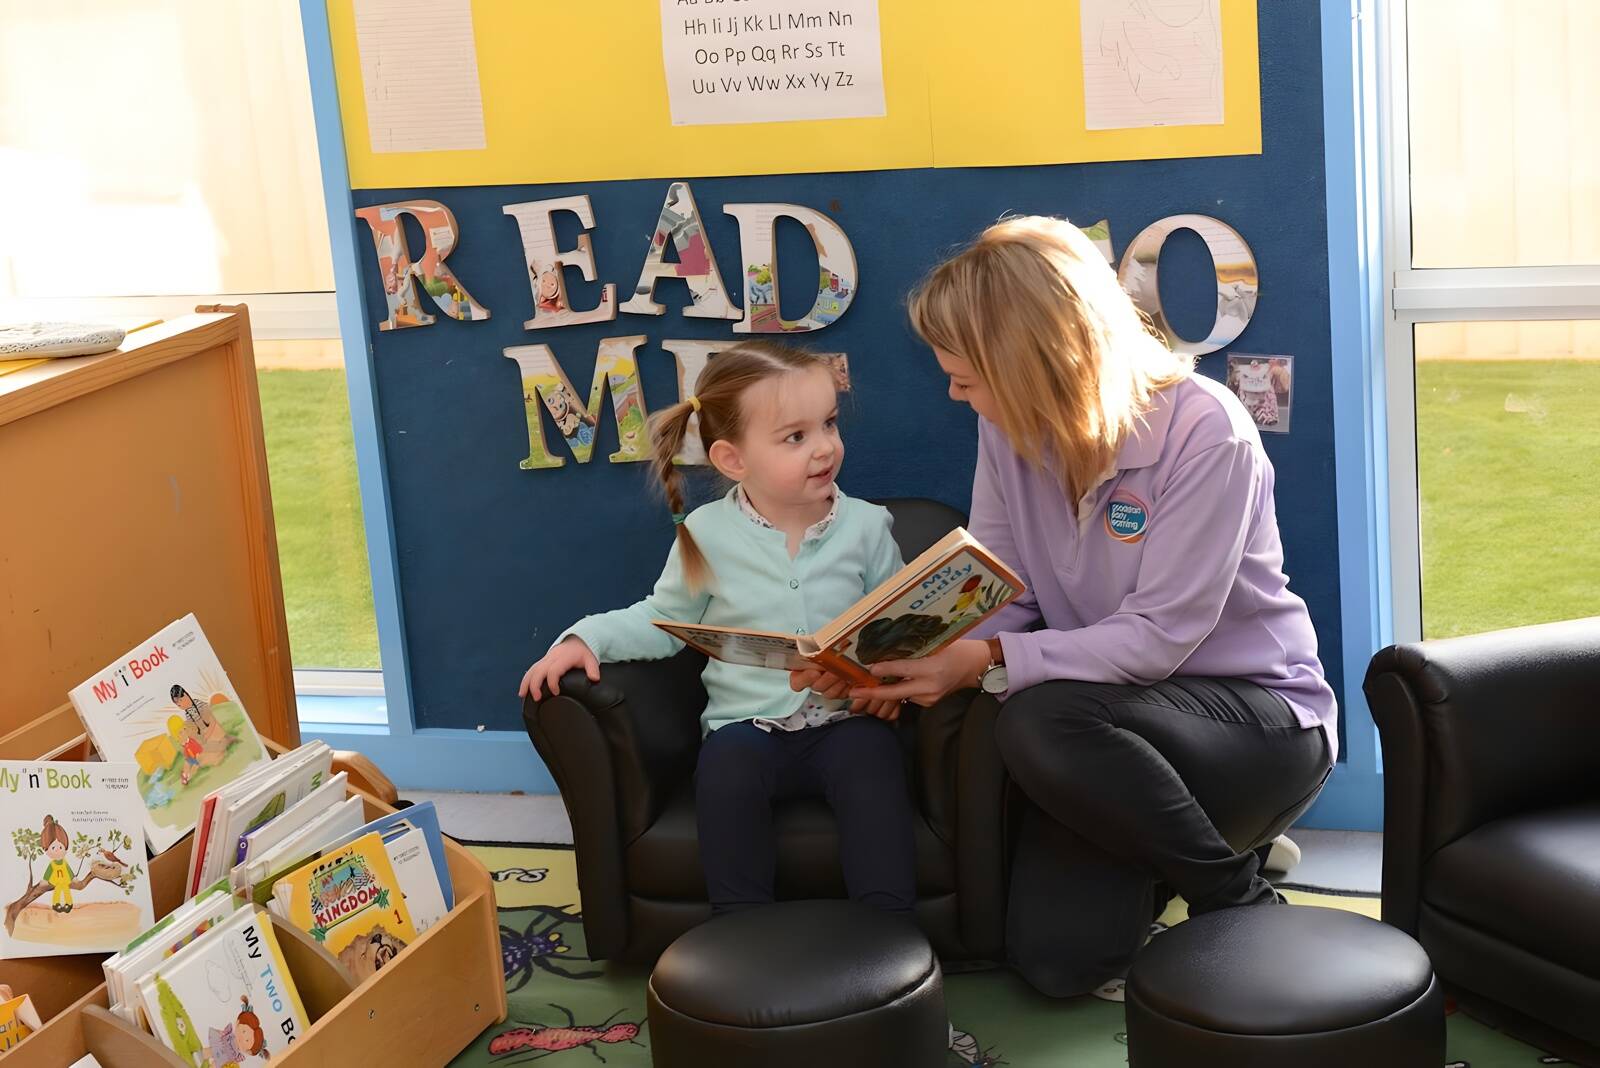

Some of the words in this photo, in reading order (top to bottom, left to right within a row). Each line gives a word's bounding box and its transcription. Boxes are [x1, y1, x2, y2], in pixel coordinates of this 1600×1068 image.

[684, 19, 707, 36] Hh
[712, 17, 722, 34] Ii
[727, 17, 738, 37] Jj
[744, 15, 764, 32] Kk
[769, 13, 781, 31] Ll
[788, 13, 822, 30] Mm
[829, 11, 853, 27] Nn
[695, 48, 719, 65] Oo
[725, 47, 746, 66] Pp
[751, 46, 776, 64] Qq
[782, 44, 800, 60] Rr
[805, 42, 823, 59] Ss
[827, 41, 846, 57] Tt
[692, 78, 716, 95] Uu
[720, 77, 742, 93] Vv
[747, 75, 780, 92] Ww
[786, 73, 806, 90] Xx
[810, 71, 830, 91] Yy
[835, 71, 854, 87] Zz
[355, 182, 859, 334] READ
[1080, 212, 1260, 356] O
[909, 563, 972, 610] Daddy
[921, 566, 952, 590] My
[92, 679, 118, 704] My
[128, 645, 170, 680] Book
[46, 767, 92, 789] Book
[315, 885, 380, 928] KINGDOM
[394, 909, 403, 925] 1
[243, 925, 262, 959] My
